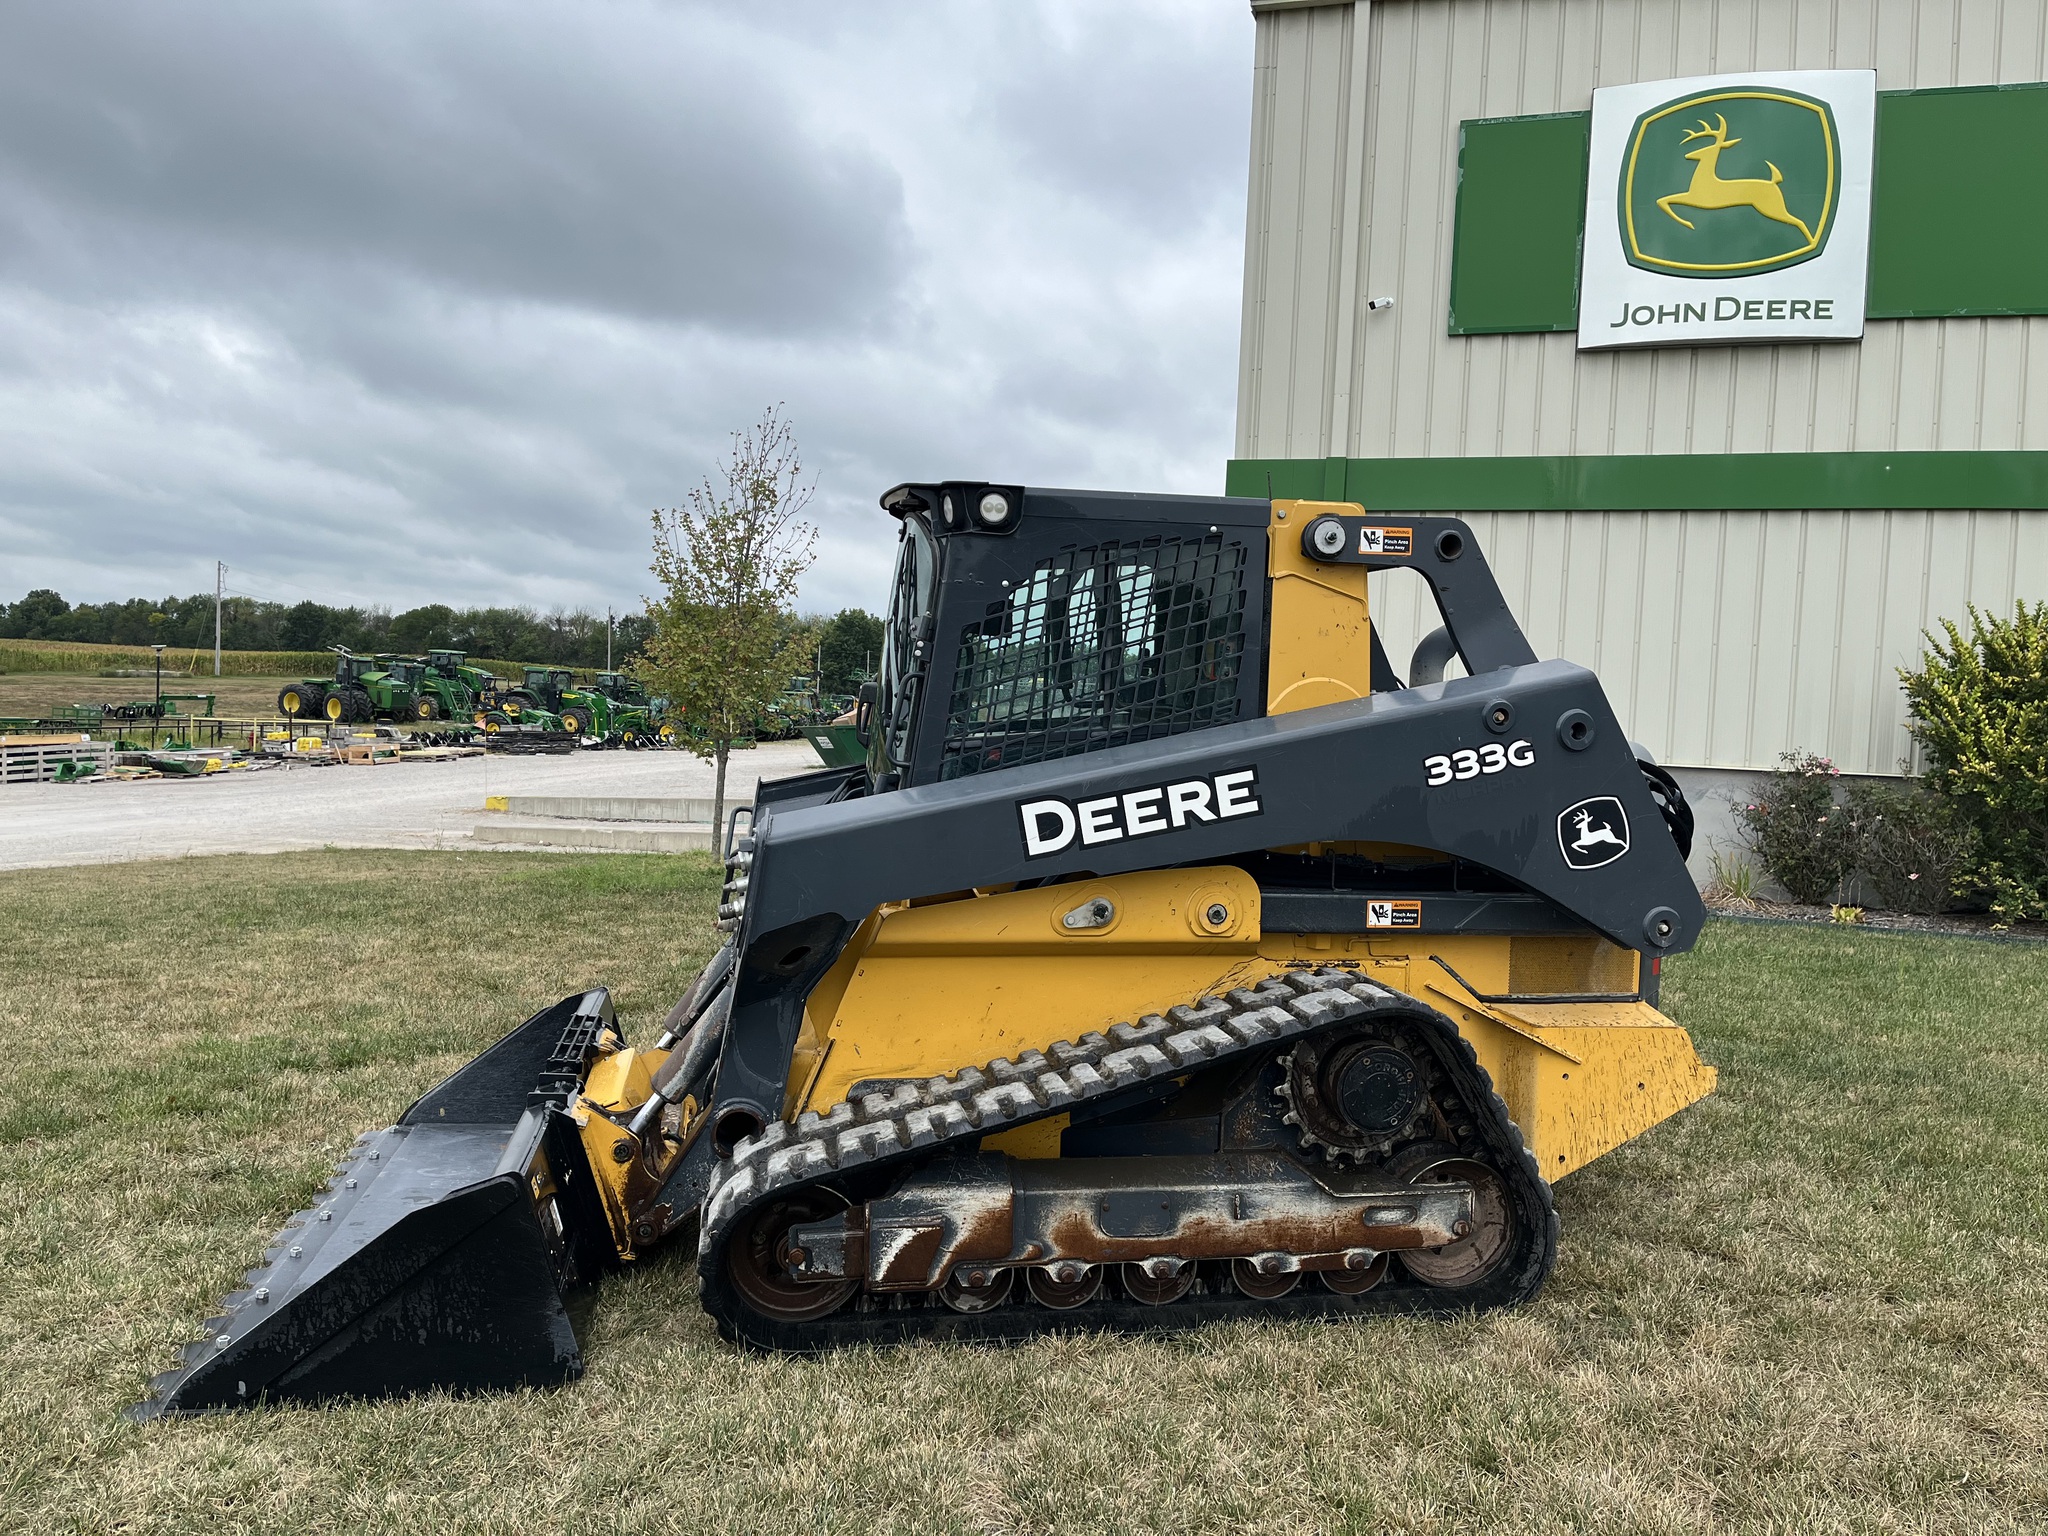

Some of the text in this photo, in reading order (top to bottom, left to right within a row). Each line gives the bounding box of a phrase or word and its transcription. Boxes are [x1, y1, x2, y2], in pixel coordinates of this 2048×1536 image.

[1610, 296, 1834, 328] JOHN DEERE
[1424, 739, 1536, 786] 333G
[1021, 769, 1259, 856] DEERE
